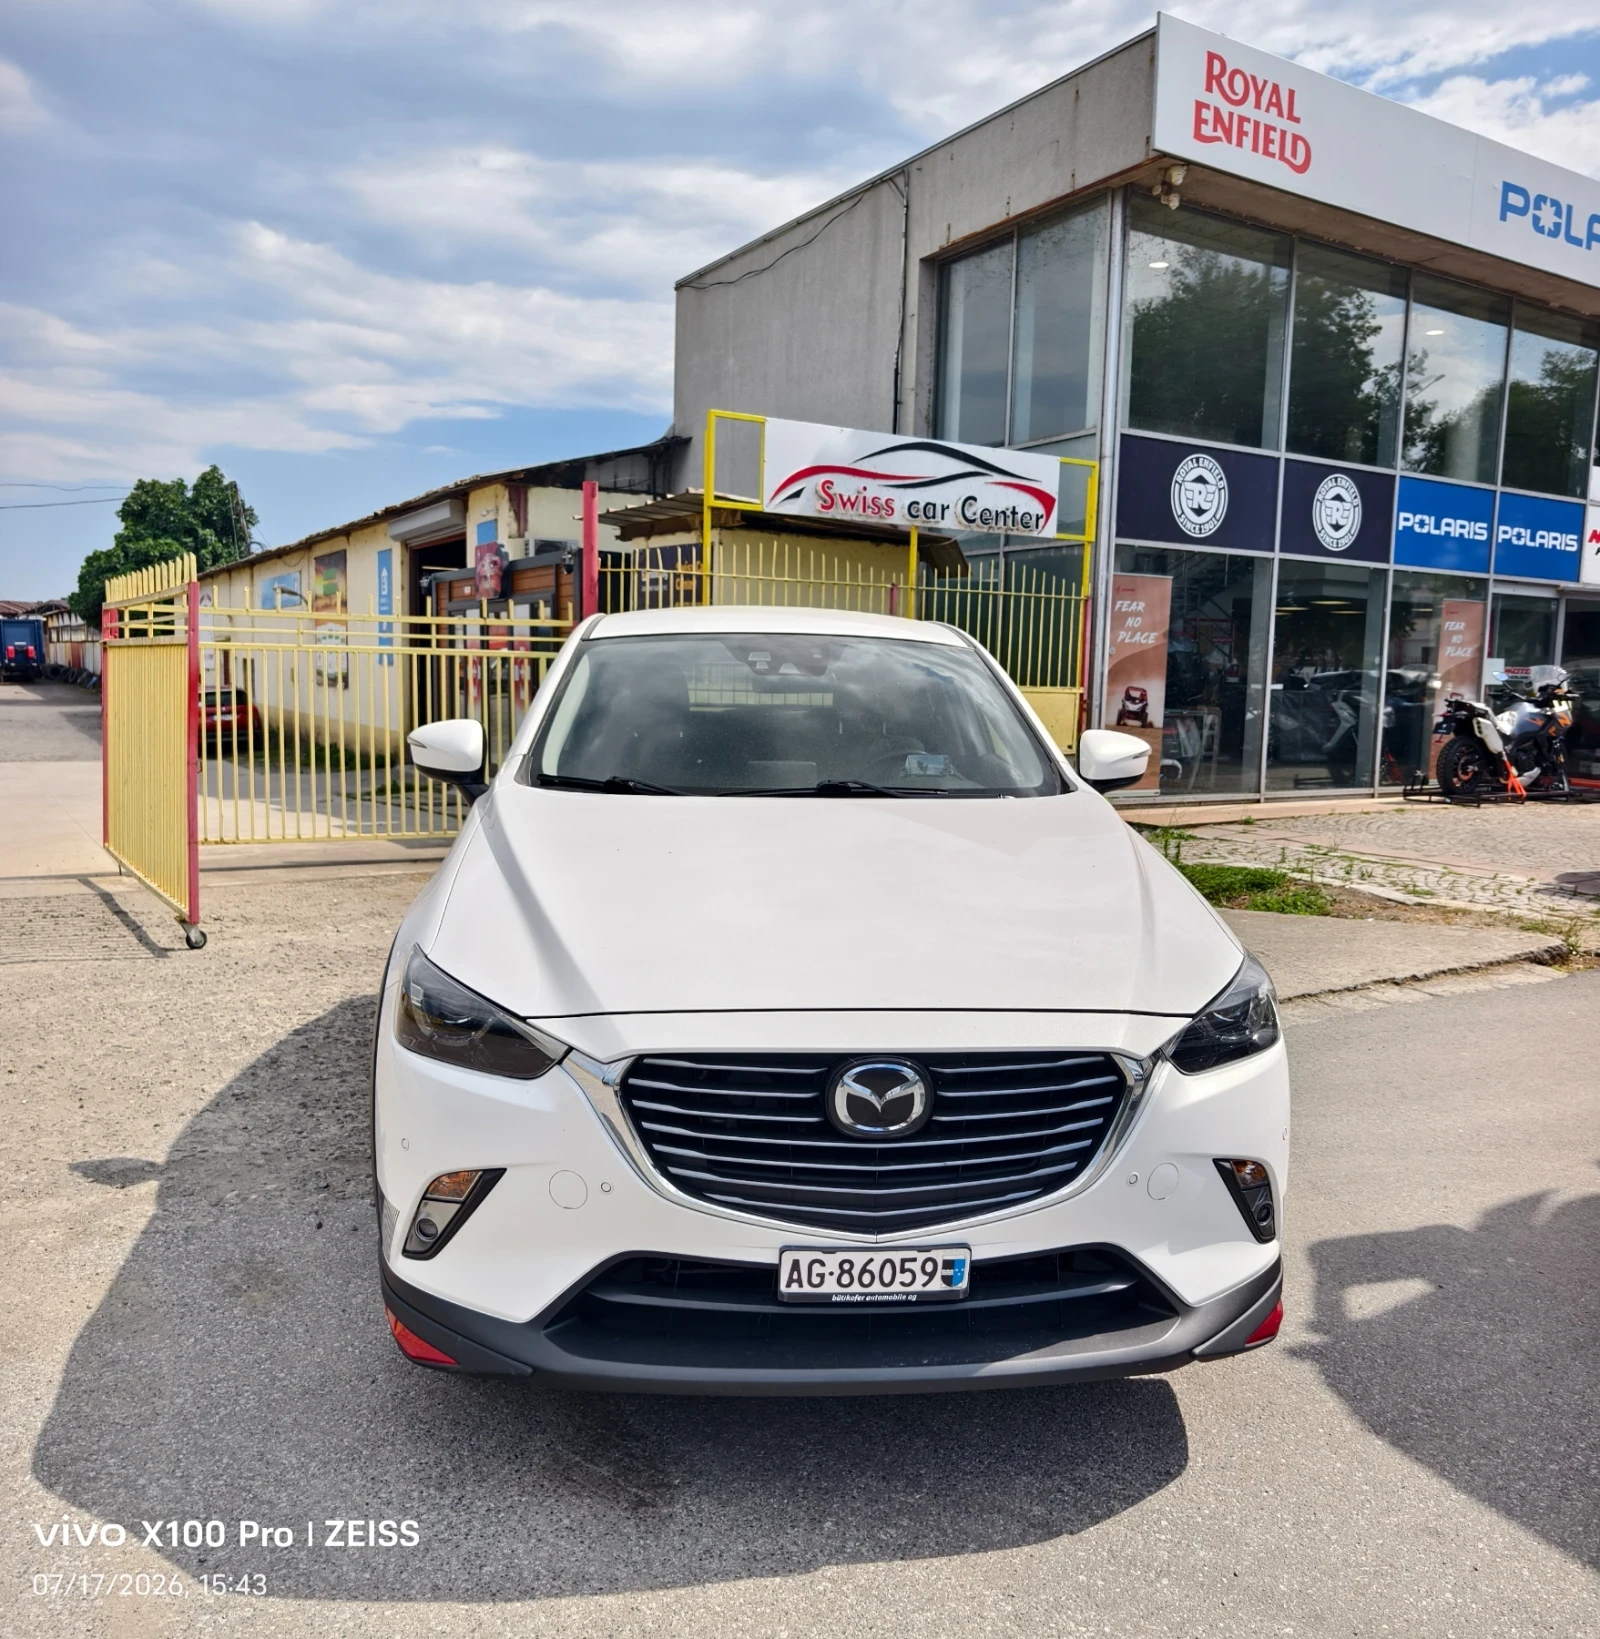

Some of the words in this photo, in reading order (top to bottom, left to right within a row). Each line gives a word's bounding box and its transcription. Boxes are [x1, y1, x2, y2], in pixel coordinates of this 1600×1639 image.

[1205, 50, 1301, 125] ROYAL
[1193, 98, 1312, 175] ENFIELD
[1175, 458, 1198, 485] ROYAL
[1199, 457, 1225, 489] ENFIELD
[1317, 477, 1337, 502] ROYAL
[818, 479, 896, 518] Swiss
[906, 499, 950, 521] car
[959, 494, 1044, 531] Center
[1179, 514, 1200, 534] SINCE
[1200, 517, 1218, 534] 1901
[1398, 511, 1488, 541] POLARIS
[1498, 525, 1578, 552] POLARIS
[1114, 600, 1146, 613] FEAR
[1124, 616, 1142, 628] NO
[1116, 630, 1158, 645] PLACE
[865, 1293, 907, 1302] automobile
